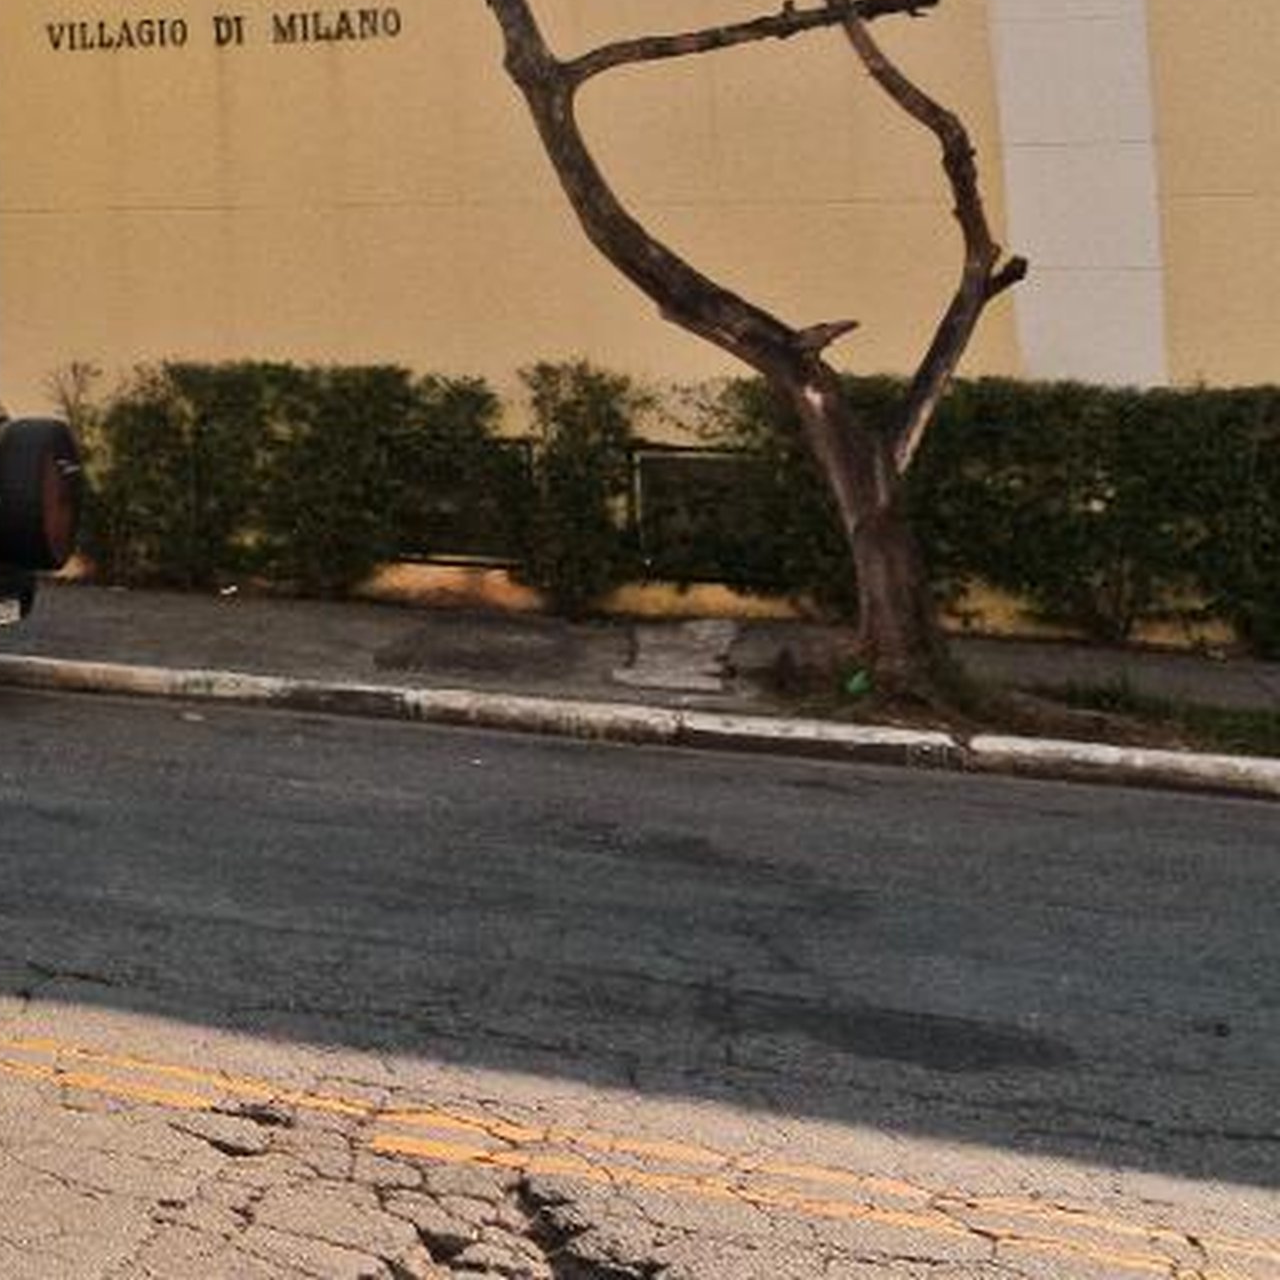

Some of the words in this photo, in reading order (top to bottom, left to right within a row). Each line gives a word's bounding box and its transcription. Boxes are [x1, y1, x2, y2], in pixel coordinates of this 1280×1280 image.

[46, 19, 188, 51] VILLAGIO
[213, 16, 244, 46] DI
[272, 8, 402, 44] MILANO
